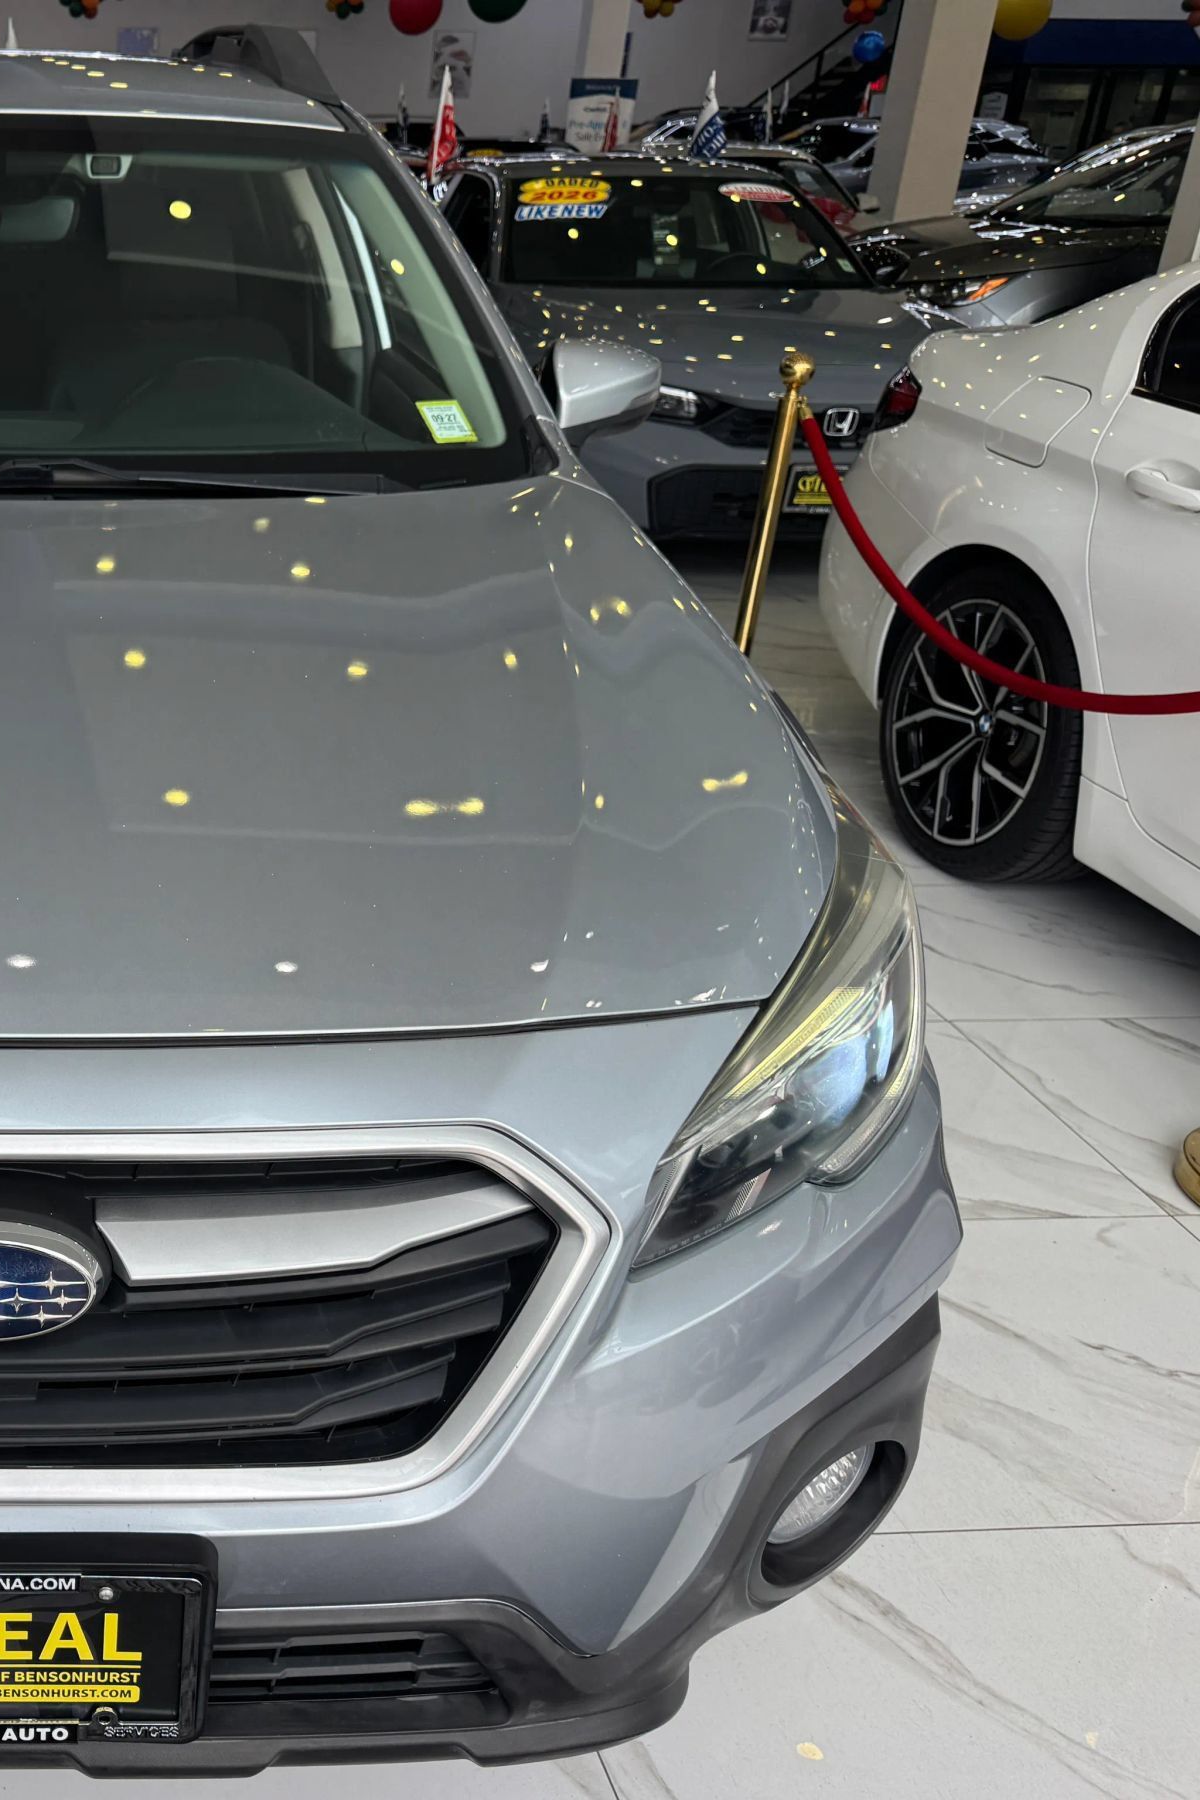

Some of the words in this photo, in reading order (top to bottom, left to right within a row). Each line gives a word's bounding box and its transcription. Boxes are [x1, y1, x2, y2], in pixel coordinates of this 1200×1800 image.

[530, 190, 598, 202] 2026
[14, 1671, 141, 1684] BENSONHURST
[1, 1727, 69, 1742] AUTO
[104, 1725, 179, 1738] SERVICES
